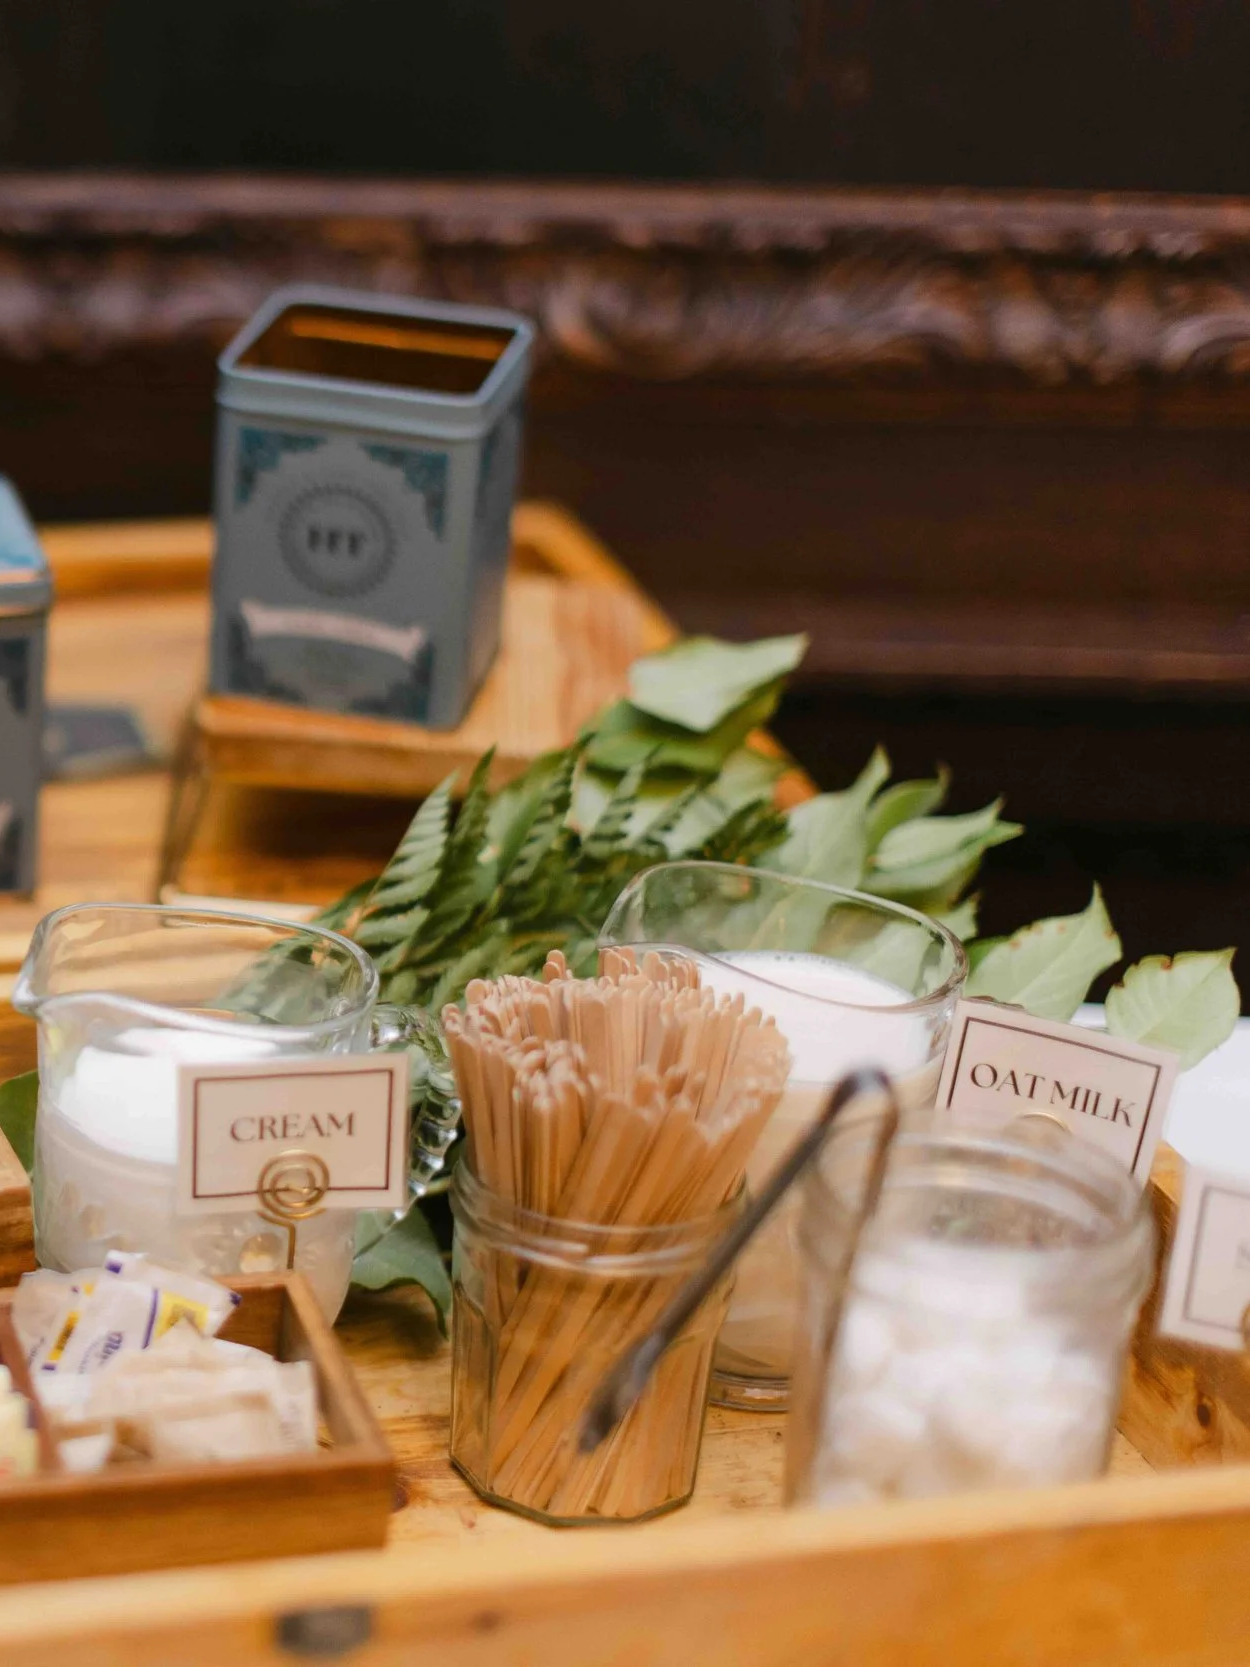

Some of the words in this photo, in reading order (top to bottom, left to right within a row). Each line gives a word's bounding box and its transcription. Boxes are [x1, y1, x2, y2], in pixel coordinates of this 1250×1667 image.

[969, 1062, 1046, 1100] OAT
[1049, 1079, 1137, 1128] MILK
[229, 1110, 356, 1142] CREAM
